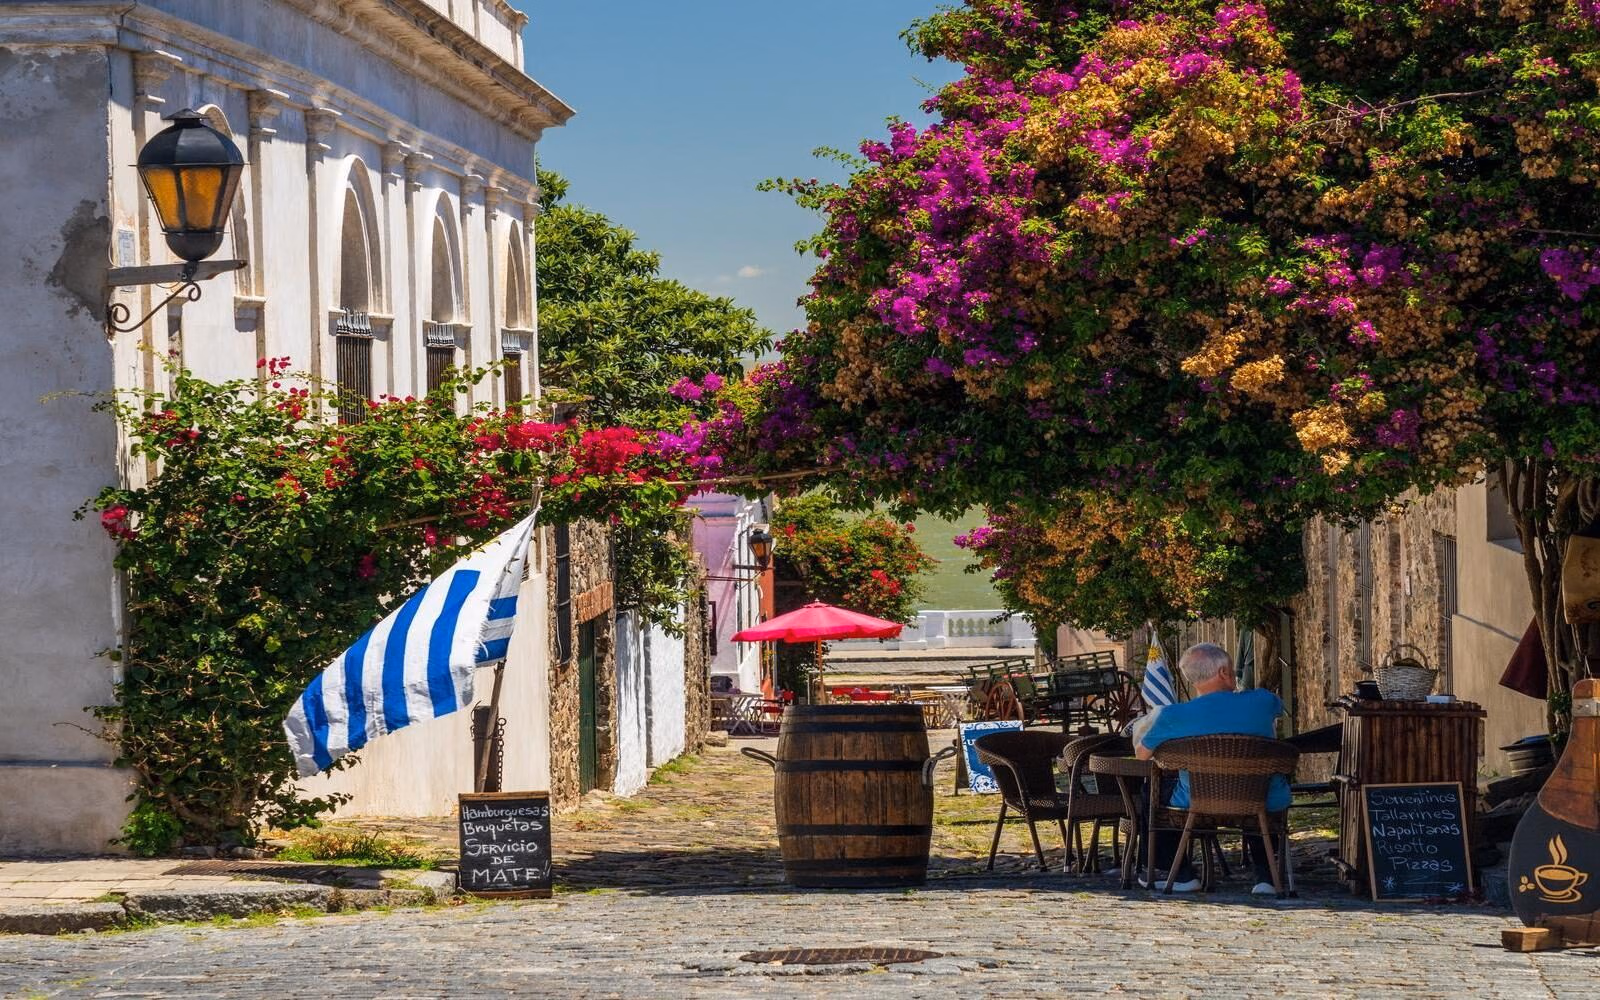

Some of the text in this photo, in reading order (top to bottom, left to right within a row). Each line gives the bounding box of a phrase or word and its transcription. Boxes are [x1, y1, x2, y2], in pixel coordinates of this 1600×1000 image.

[462, 804, 548, 822] Hamburguesas
[1368, 808, 1455, 821] Tallarines
[463, 818, 543, 840] Bruquetas
[1372, 823, 1460, 840] Napolitanas
[1376, 838, 1438, 855] Risotto
[490, 855, 516, 865] DE
[1387, 856, 1453, 872] Pizzas
